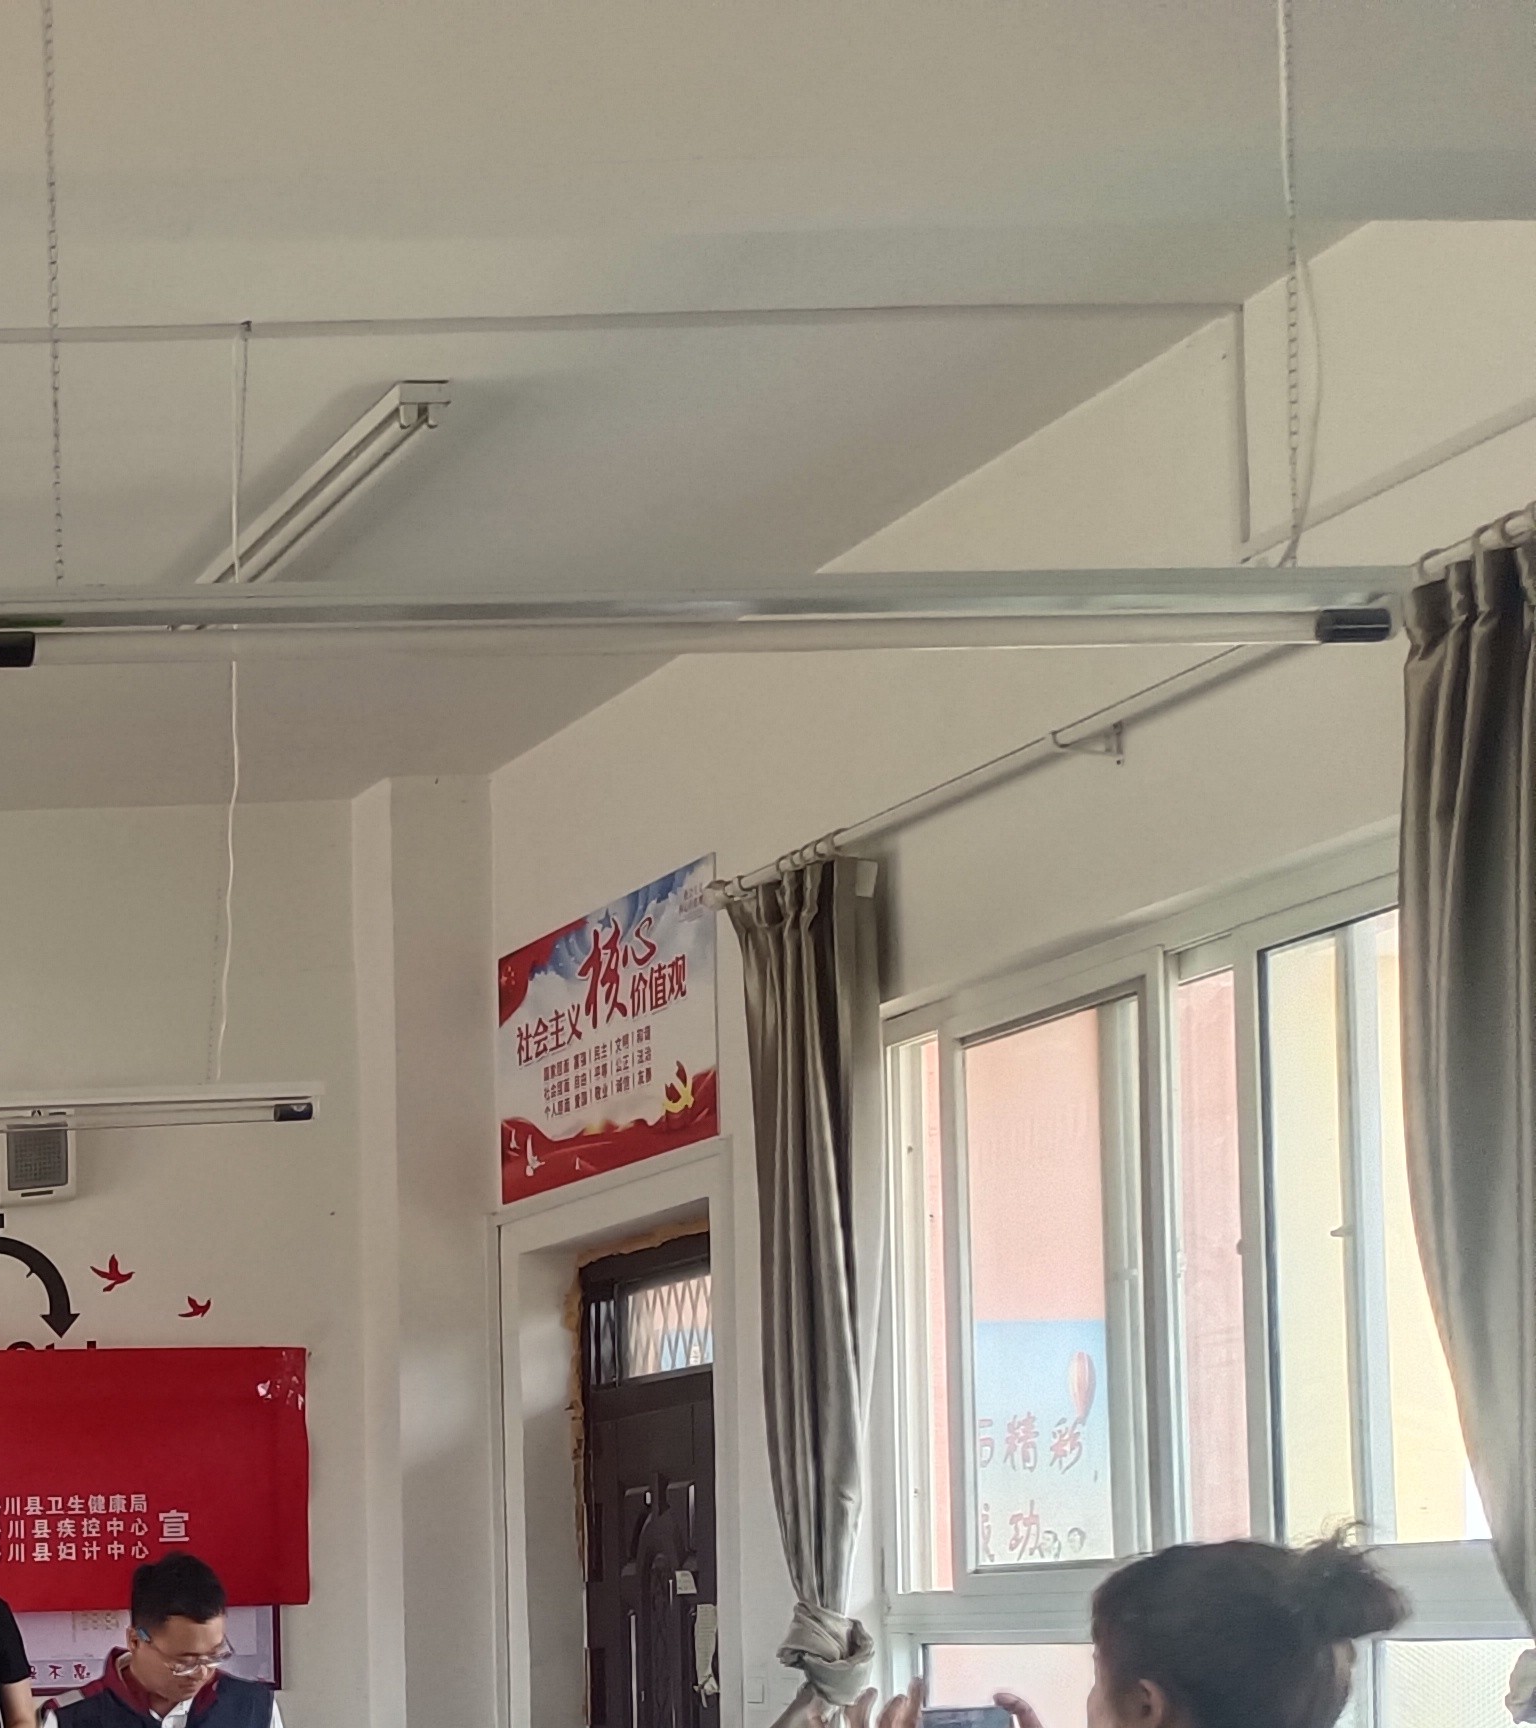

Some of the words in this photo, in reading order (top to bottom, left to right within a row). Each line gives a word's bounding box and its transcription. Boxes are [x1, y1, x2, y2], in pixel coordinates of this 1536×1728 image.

[516, 1004, 582, 1066] 社会主义
[630, 954, 686, 1017] 价值观
[158, 1509, 189, 1542] 宣
